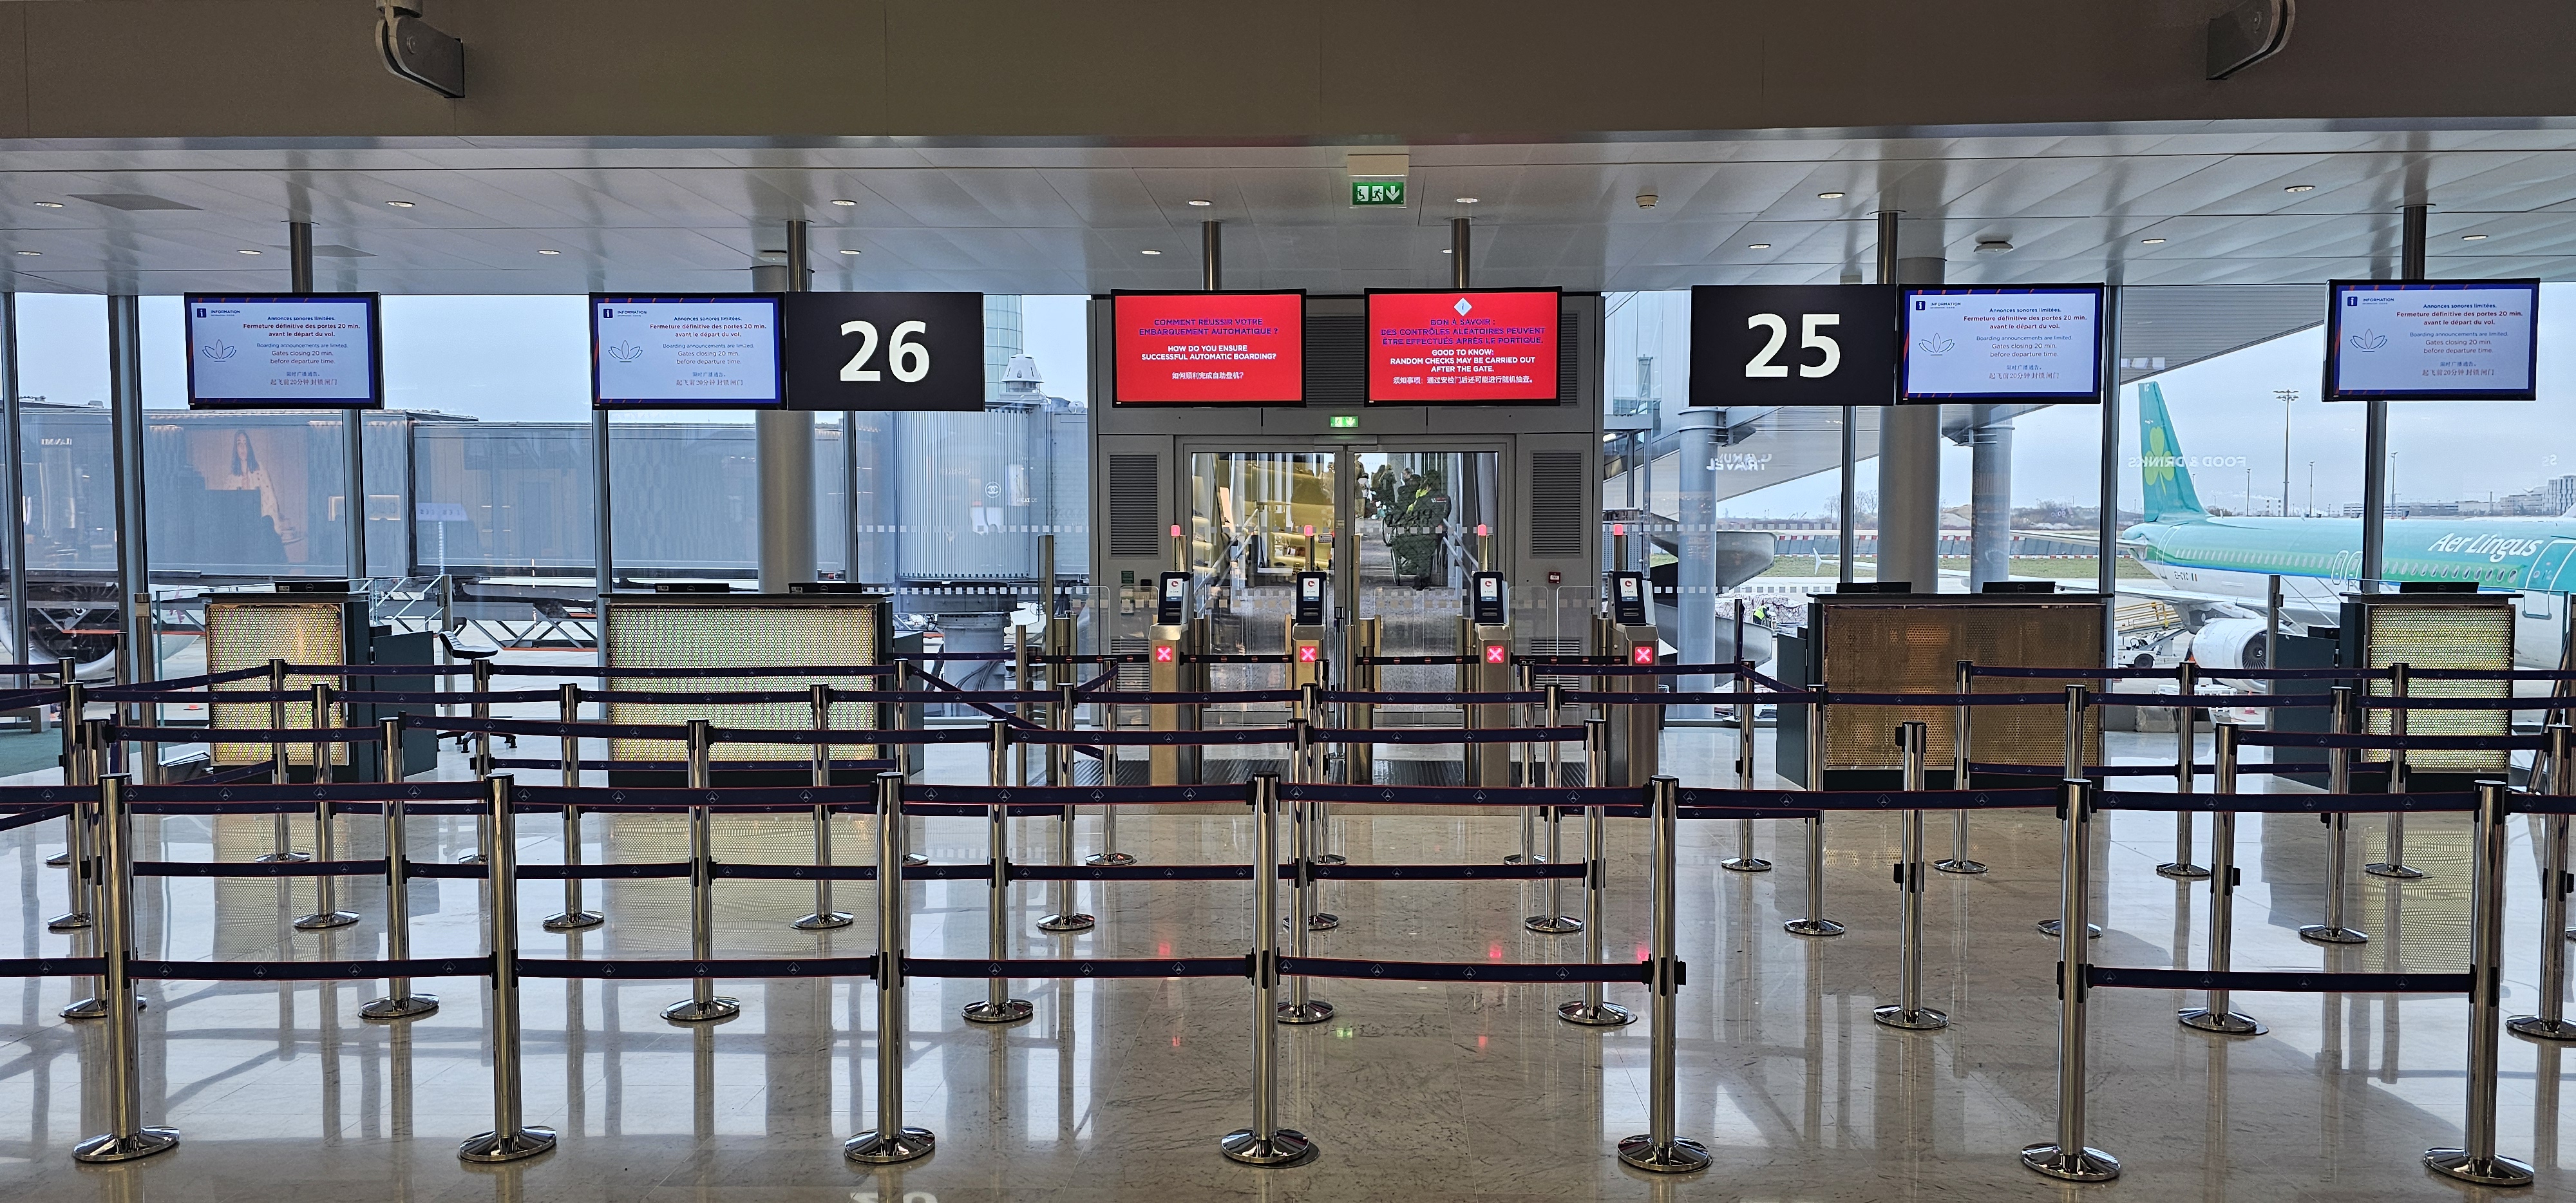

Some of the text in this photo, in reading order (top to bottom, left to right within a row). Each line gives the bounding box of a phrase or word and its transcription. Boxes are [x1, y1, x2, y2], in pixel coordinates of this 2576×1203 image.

[840, 321, 929, 382] 26
[1746, 313, 1841, 377] 25
[2428, 533, 2544, 563] Aer Lingus
